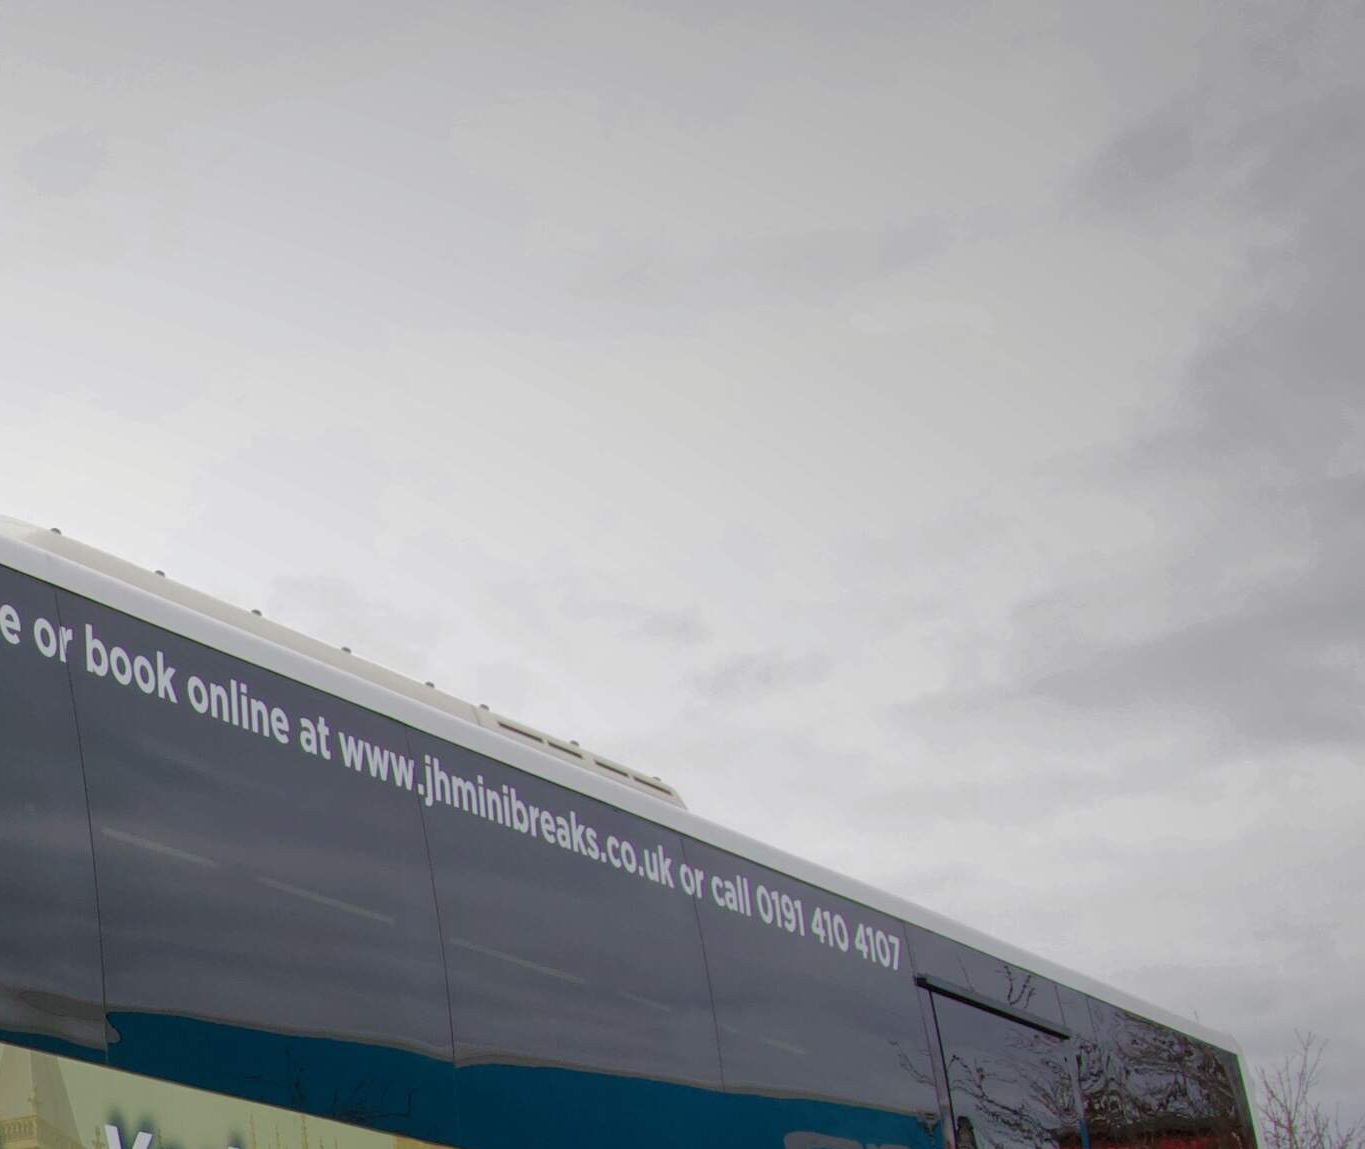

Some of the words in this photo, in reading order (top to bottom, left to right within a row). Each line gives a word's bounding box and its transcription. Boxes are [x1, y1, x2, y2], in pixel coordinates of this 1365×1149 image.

[32, 616, 73, 663] or
[85, 623, 178, 704] book
[186, 675, 290, 745] online
[299, 715, 332, 761] at
[338, 731, 674, 890] www.jhminibreaks.co.uk
[679, 863, 705, 899] or
[710, 874, 752, 917] call
[756, 884, 806, 937] 0191
[811, 906, 850, 953] 410
[854, 922, 901, 971] 4107
